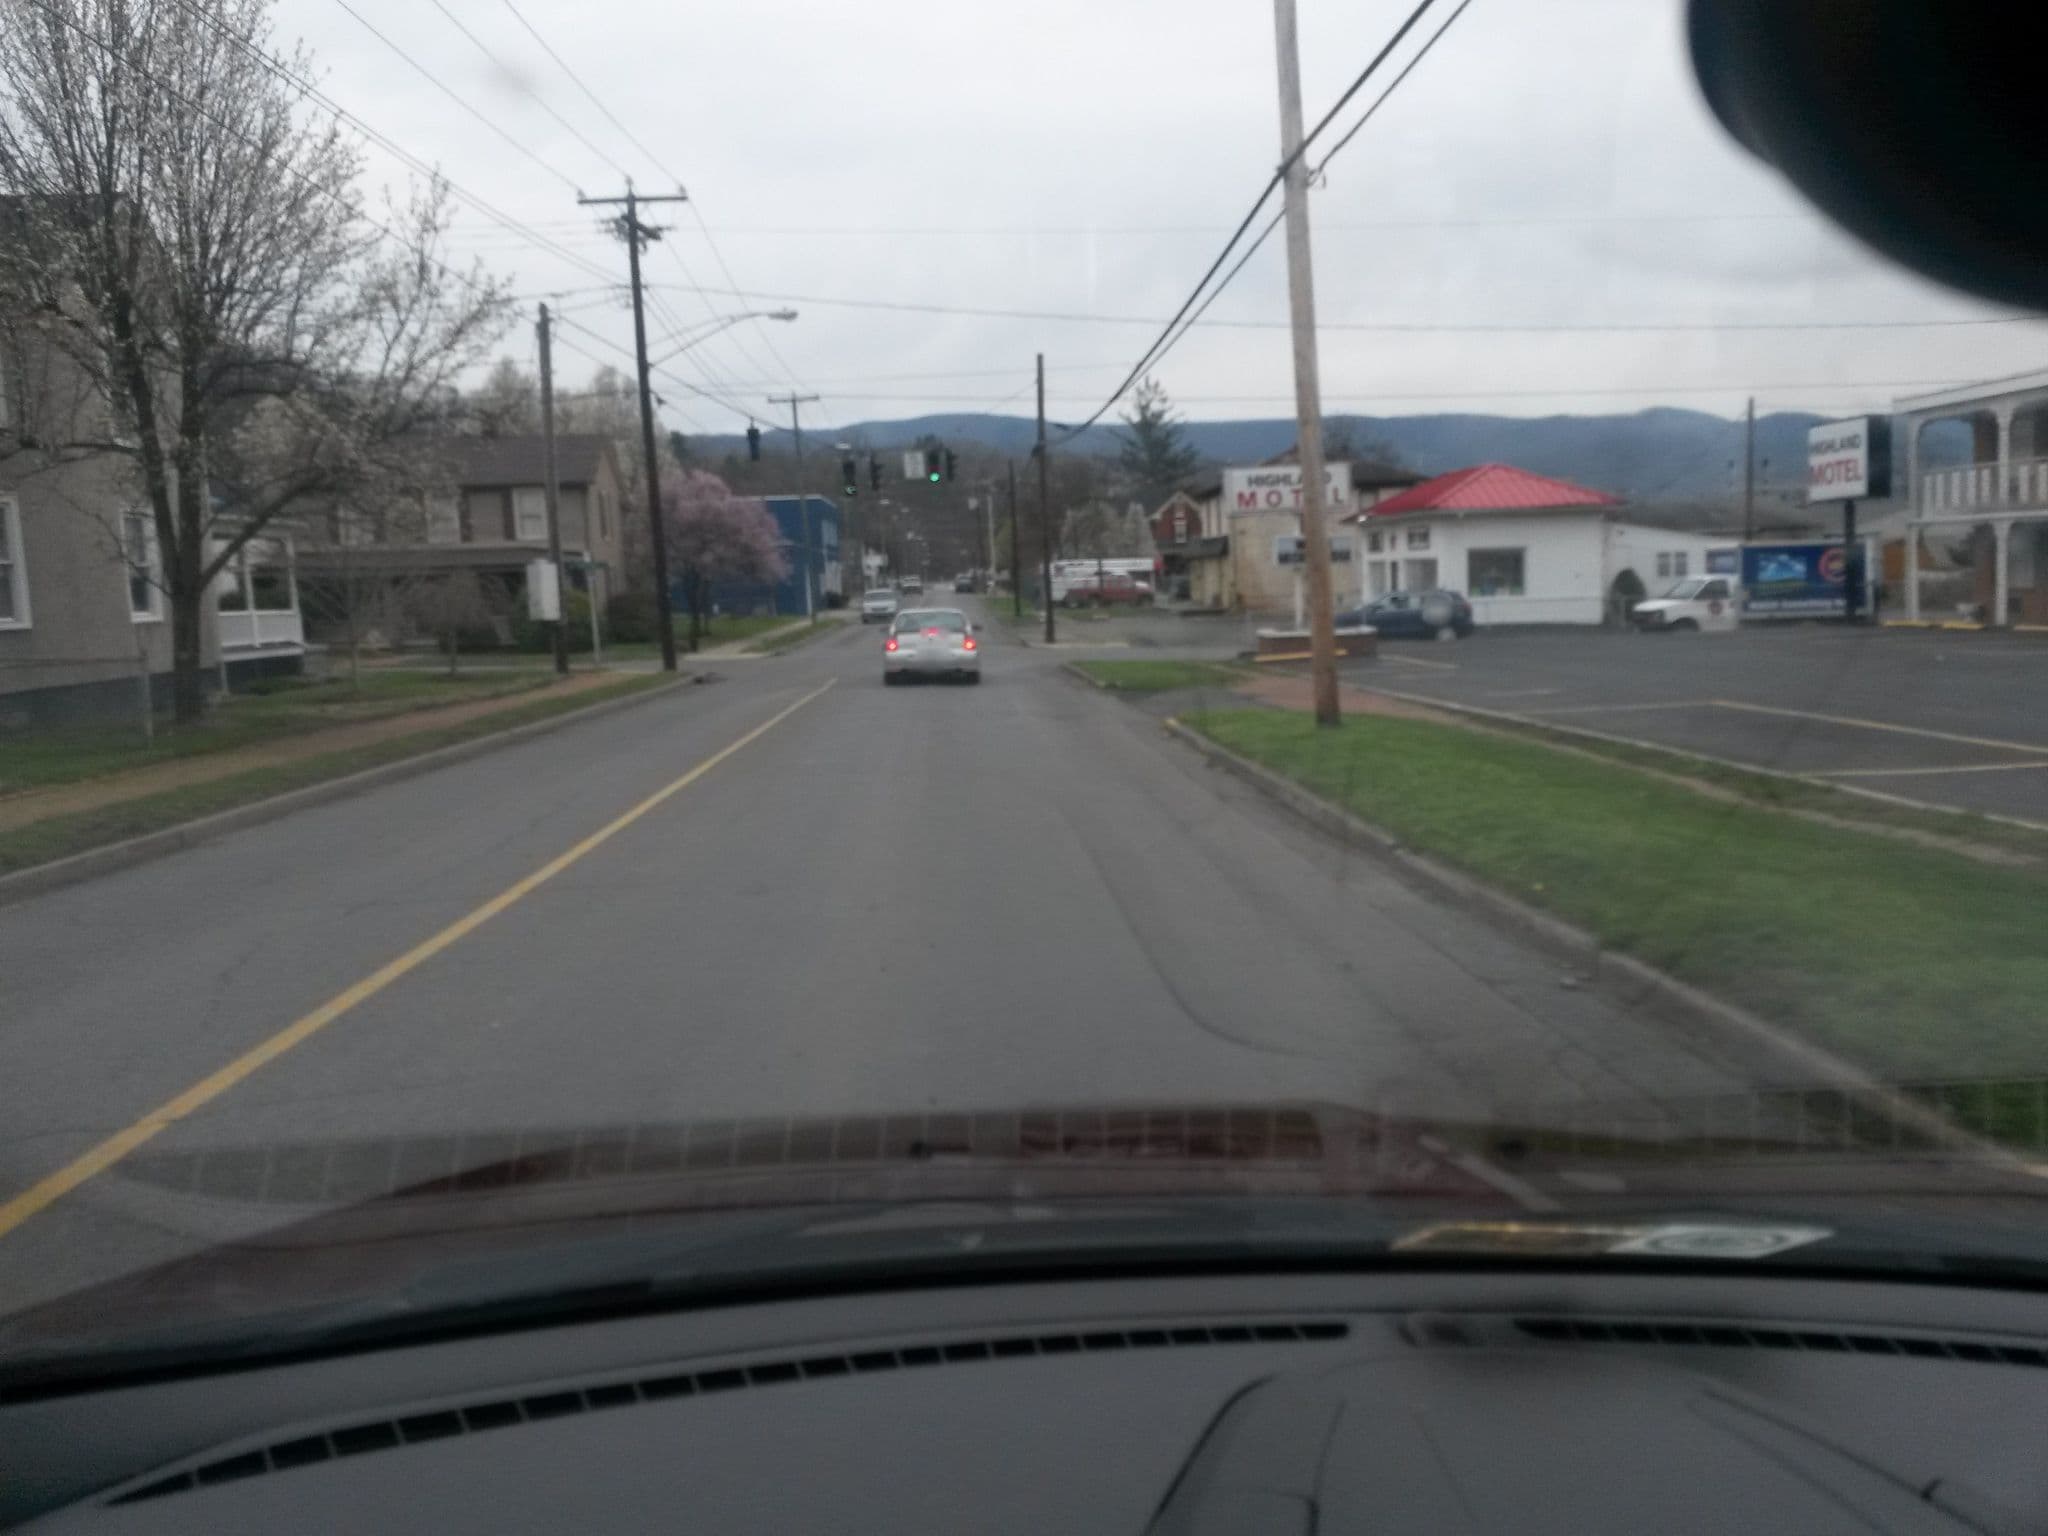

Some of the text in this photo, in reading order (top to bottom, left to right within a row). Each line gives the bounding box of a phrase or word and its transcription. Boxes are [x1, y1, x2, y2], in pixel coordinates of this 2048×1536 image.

[1247, 471, 1332, 487] HIGHLD
[1809, 459, 1862, 486] MOTEL
[1237, 487, 1344, 508] MOTL
